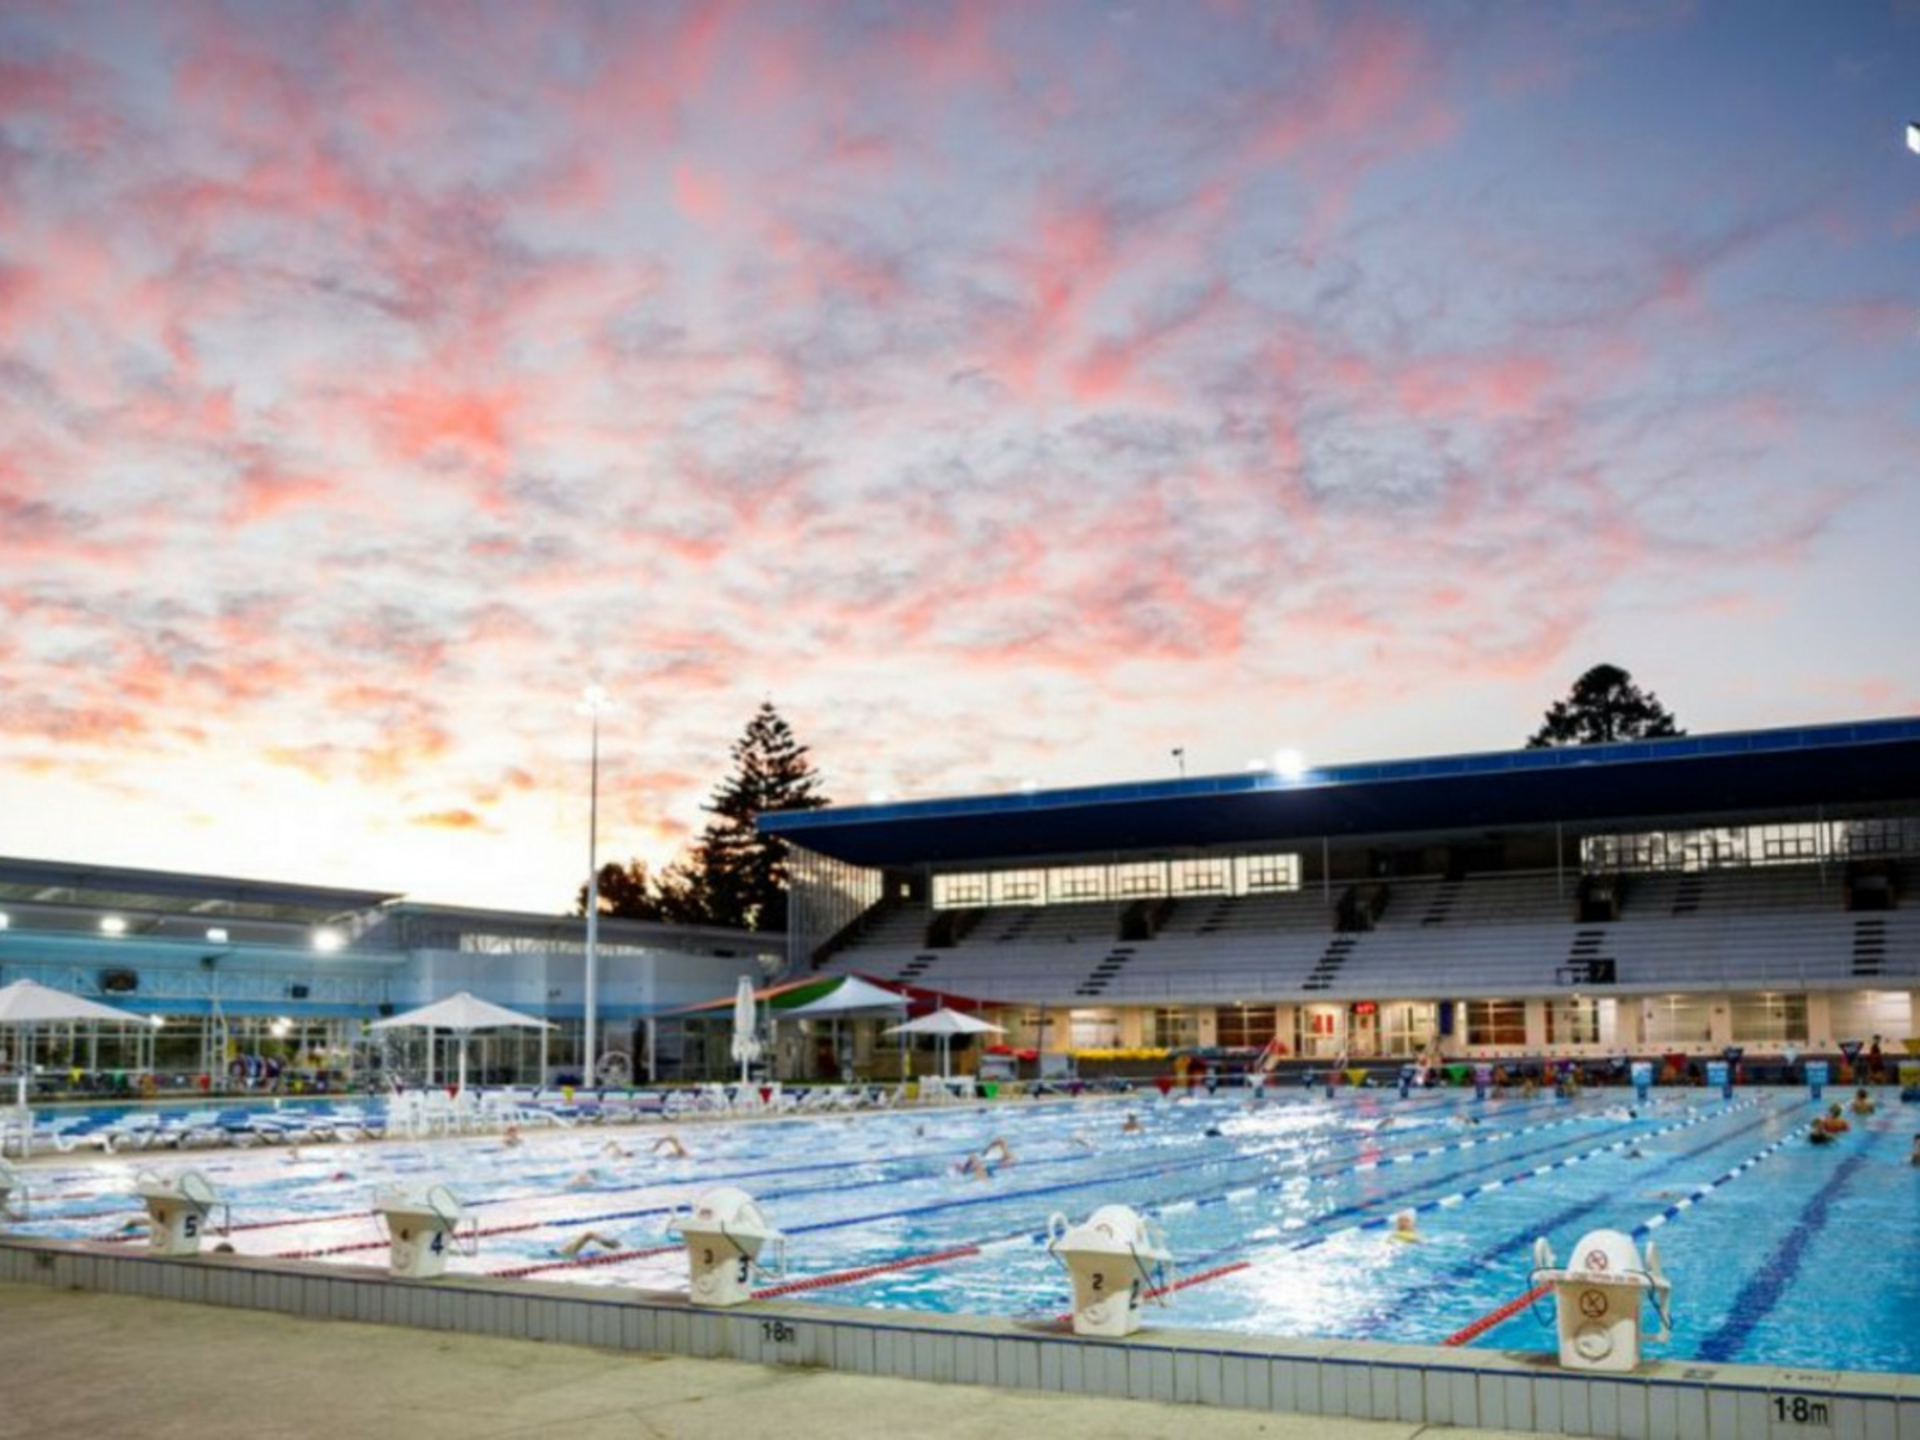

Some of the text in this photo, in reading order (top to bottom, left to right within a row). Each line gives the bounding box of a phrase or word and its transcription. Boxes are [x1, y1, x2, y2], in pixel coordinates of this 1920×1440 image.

[185, 1215, 197, 1238] 5
[430, 1231, 444, 1255] 4
[738, 1255, 749, 1283] 3
[1092, 1273, 1104, 1290] 2
